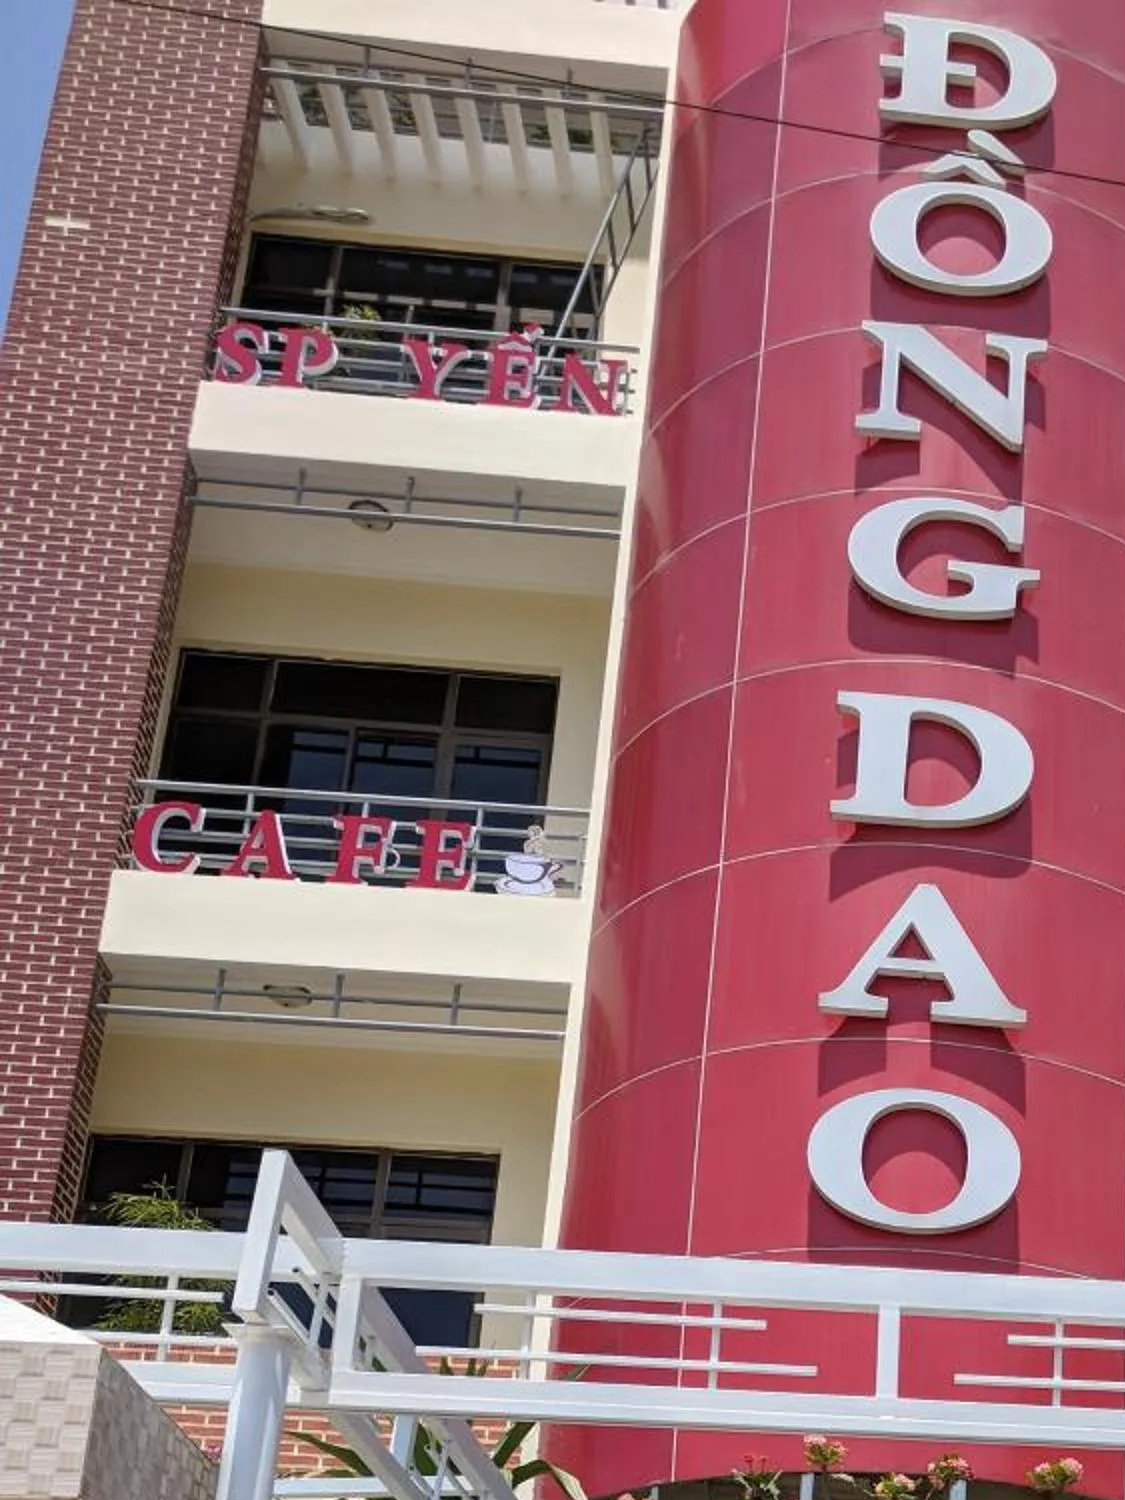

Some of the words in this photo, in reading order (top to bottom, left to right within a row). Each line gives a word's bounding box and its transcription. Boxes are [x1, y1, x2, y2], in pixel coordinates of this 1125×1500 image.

[214, 321, 338, 388] SP
[847, 11, 1057, 620] ĐỒNG
[132, 801, 478, 892] CAFE
[806, 690, 1035, 1235] DAO
